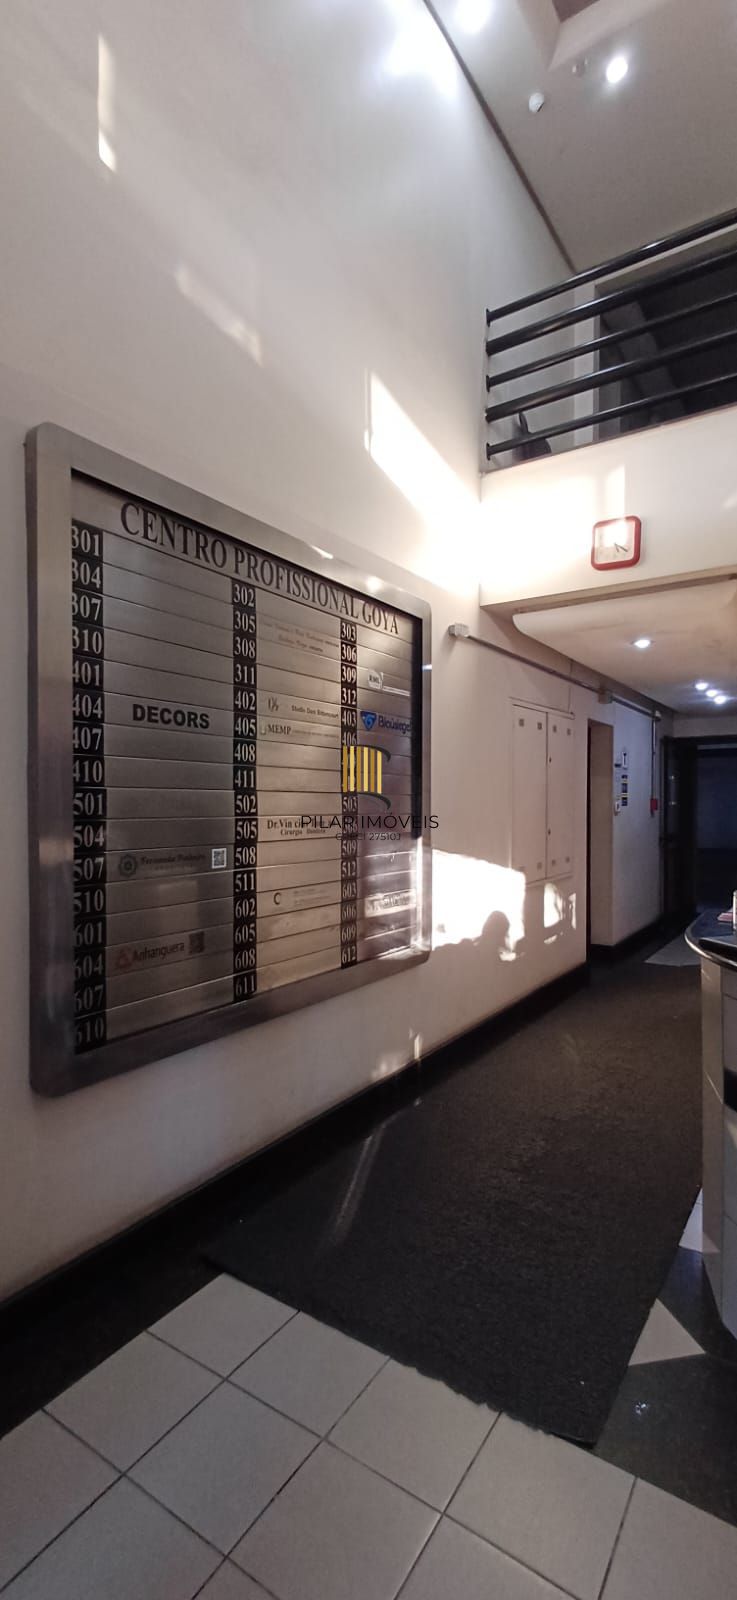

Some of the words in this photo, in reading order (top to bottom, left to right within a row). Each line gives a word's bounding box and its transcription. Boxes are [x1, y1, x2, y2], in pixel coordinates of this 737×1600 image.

[72, 526, 99, 557] 301
[72, 558, 102, 589] 304
[121, 502, 227, 568] CENTRO
[234, 547, 359, 619] PROFISSIONAL
[362, 600, 399, 635] GOYA
[234, 583, 255, 607] 302
[72, 592, 102, 621] 307
[234, 611, 256, 633] 305
[341, 622, 356, 641] 303
[72, 625, 104, 655] 310
[234, 637, 256, 659] 308
[341, 644, 357, 661] 306
[73, 660, 100, 686] 401
[235, 663, 255, 685] 311
[341, 666, 357, 683] 309
[73, 693, 103, 720] 404
[234, 690, 256, 711] 402
[342, 688, 357, 705] 312
[132, 703, 210, 729] DECORS
[342, 711, 357, 727] 403
[234, 717, 256, 737] 405
[268, 724, 292, 735] MEMP
[73, 726, 103, 750] 407
[234, 744, 256, 762] 408
[73, 759, 103, 783] 410
[235, 769, 255, 788] 411
[74, 792, 103, 816] 501
[235, 795, 257, 813] 502
[342, 797, 357, 812] 503
[74, 825, 105, 849] 504
[235, 823, 257, 840] 505
[235, 847, 256, 866] 508
[342, 840, 357, 856] 509
[74, 857, 104, 882] 507
[342, 862, 357, 878] 512
[235, 872, 256, 892] 511
[74, 889, 104, 912] 510
[235, 900, 256, 919] 602
[235, 927, 256, 945] 605
[342, 926, 357, 941] 609
[235, 949, 256, 969] 608
[342, 947, 357, 963] 612
[235, 975, 256, 996] 611
